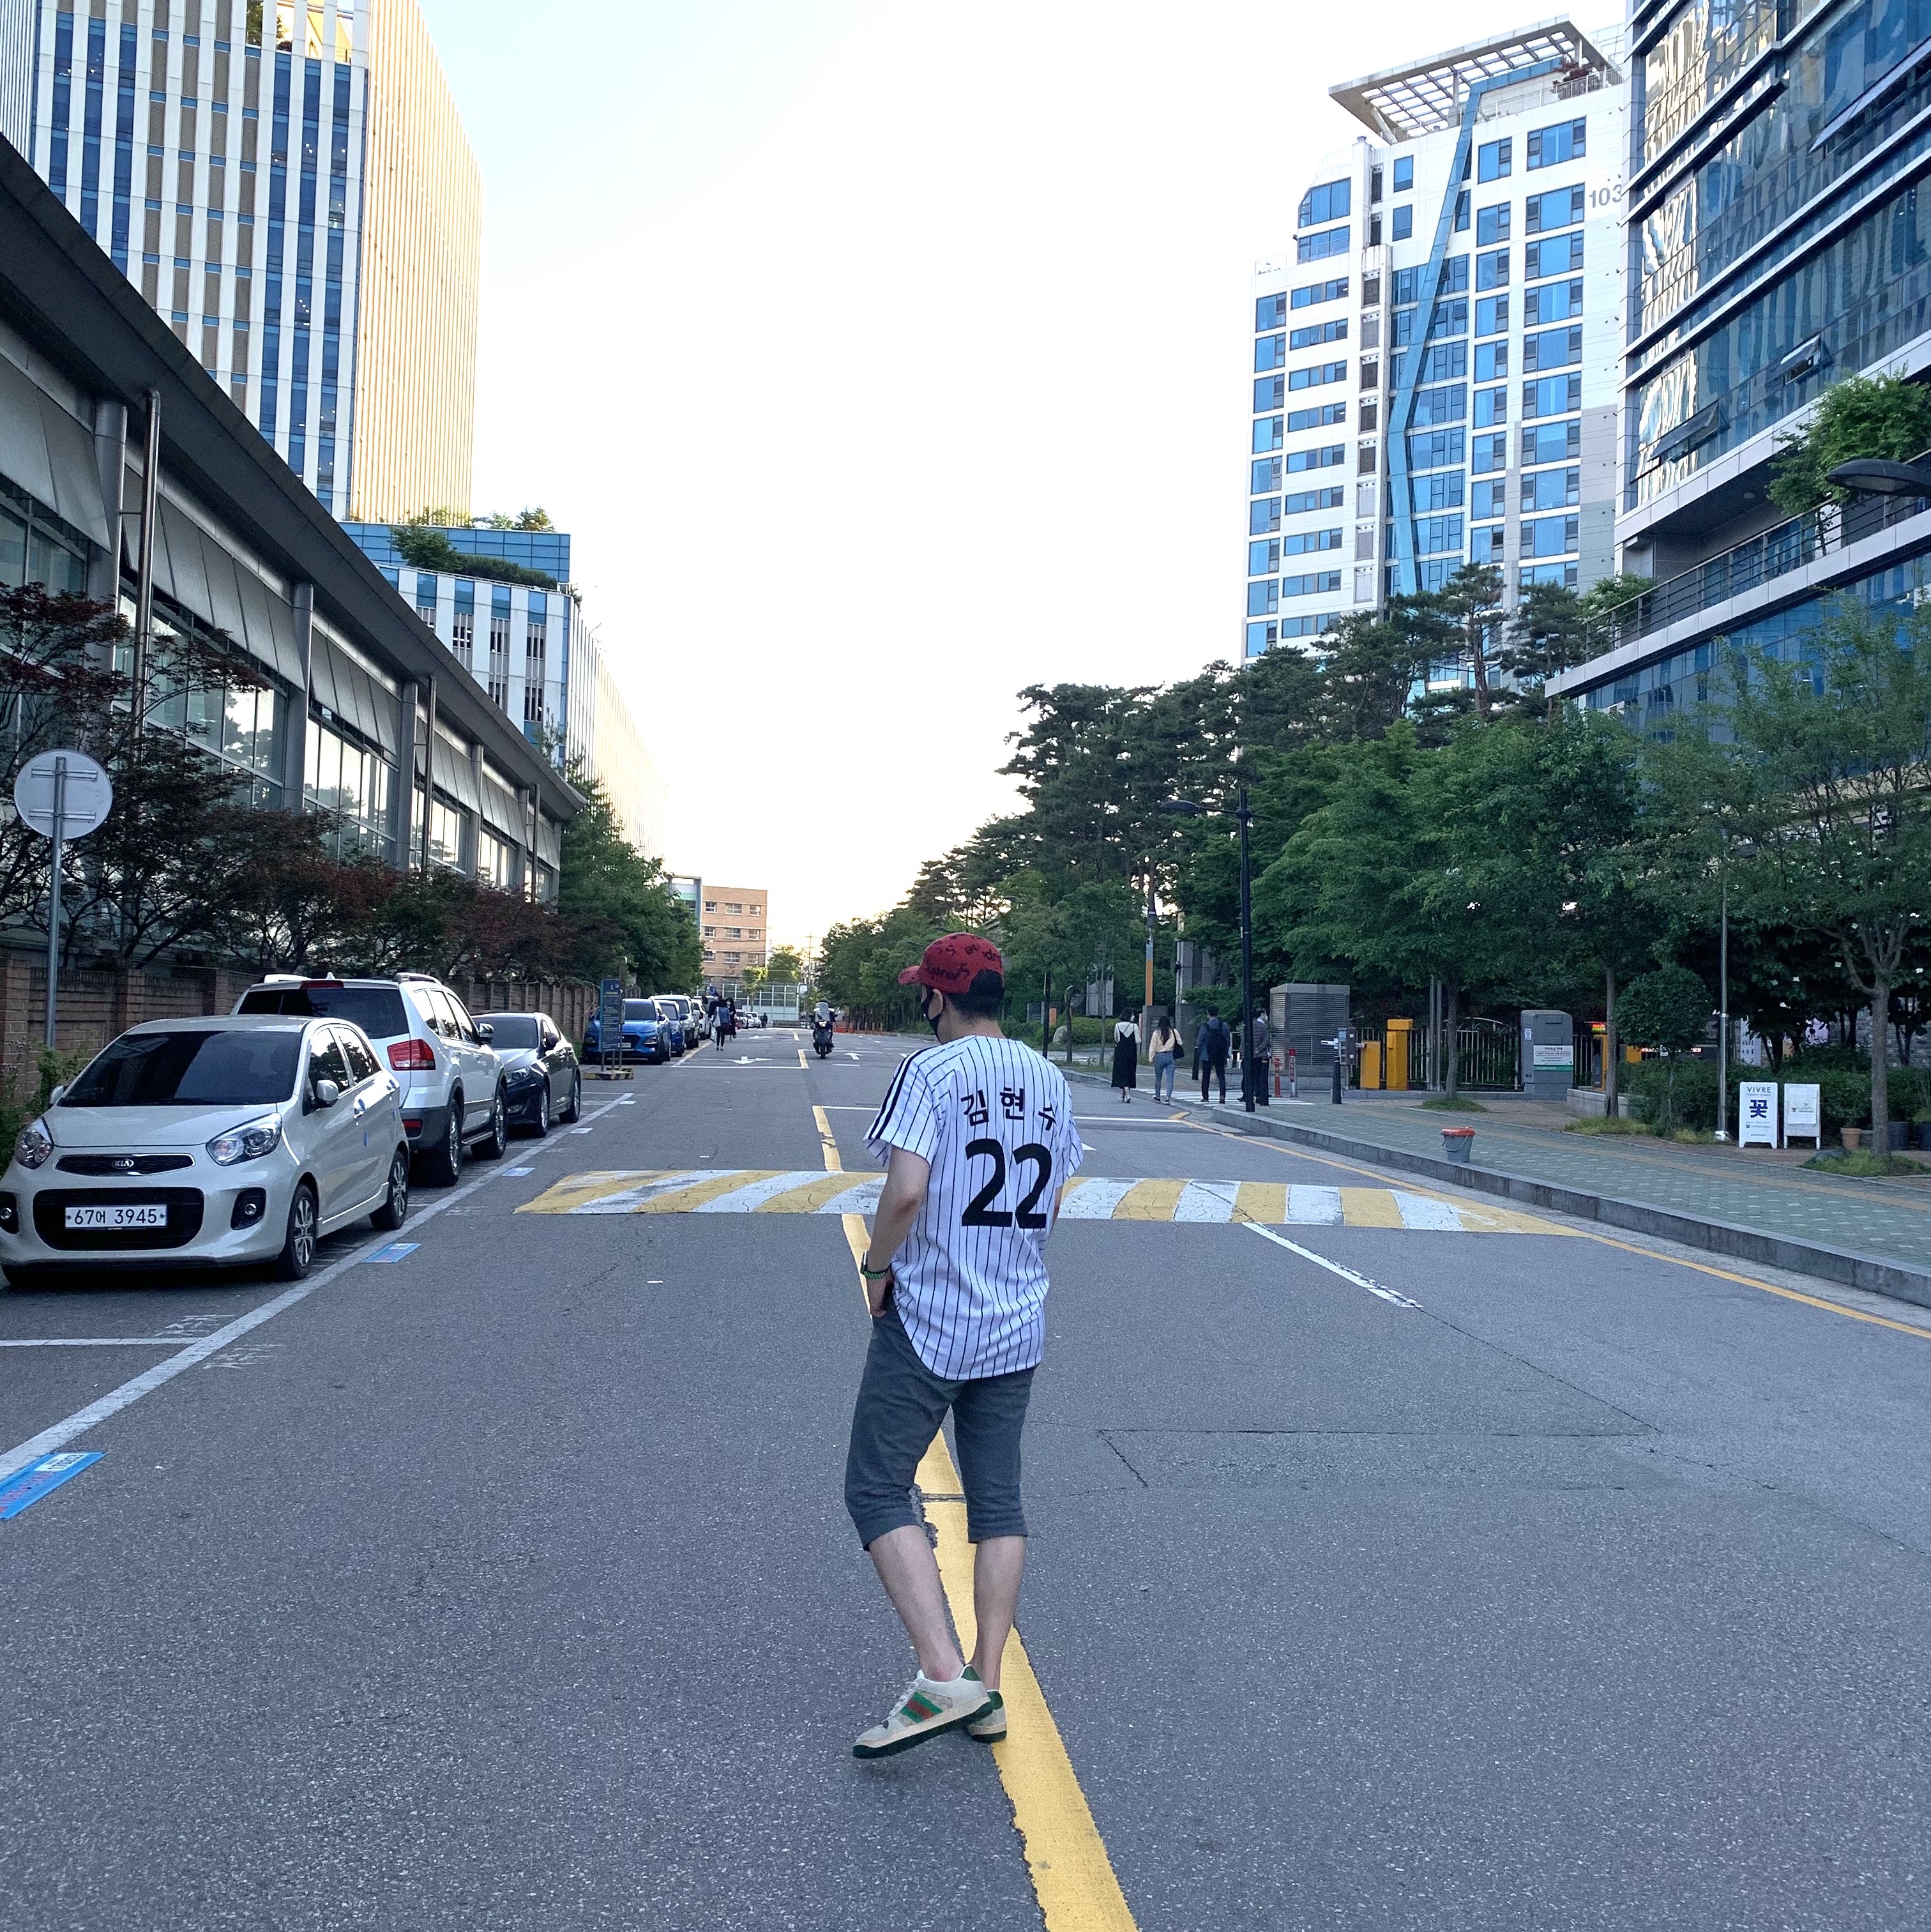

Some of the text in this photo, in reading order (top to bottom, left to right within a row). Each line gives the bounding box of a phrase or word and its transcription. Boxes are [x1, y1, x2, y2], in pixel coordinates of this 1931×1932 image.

[1589, 184, 1623, 208] 103
[1749, 1099, 1768, 1118] 꽃
[114, 1159, 132, 1168] KIA
[961, 1138, 1052, 1229] 22
[74, 1208, 157, 1225] 67어 3945
